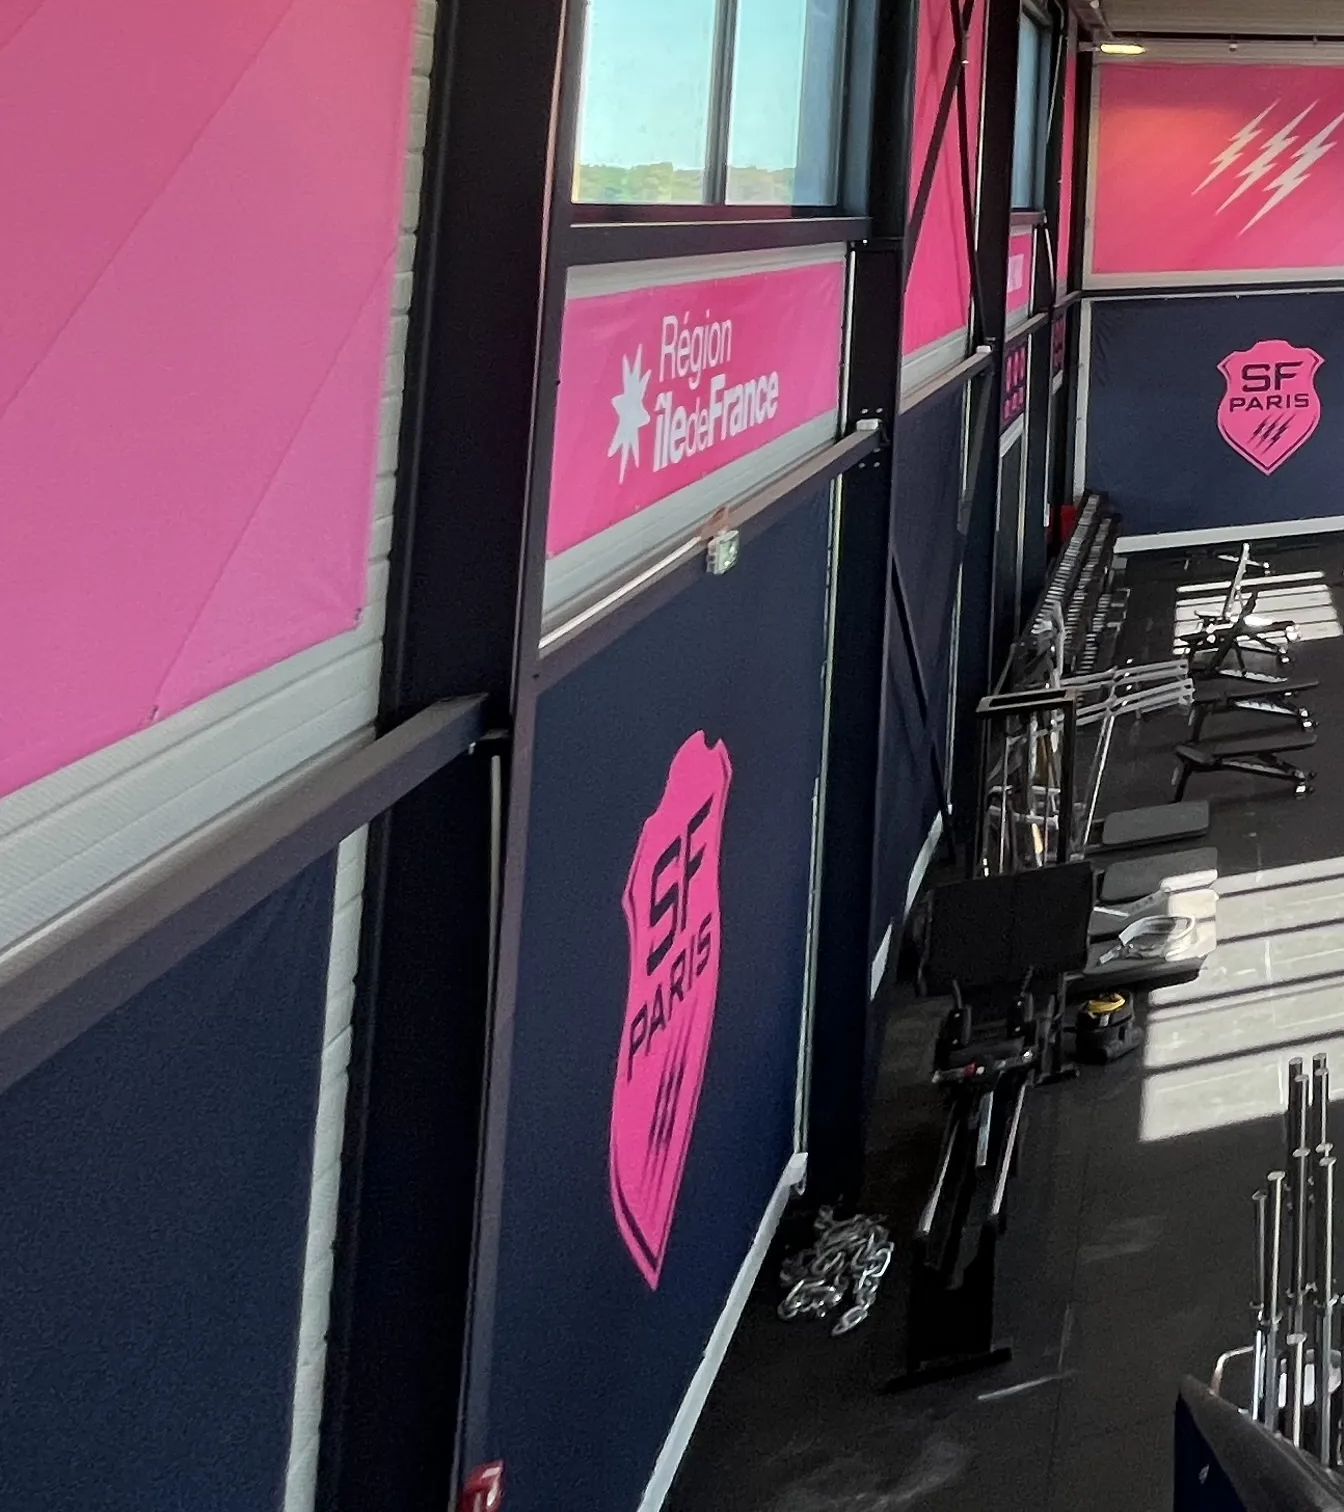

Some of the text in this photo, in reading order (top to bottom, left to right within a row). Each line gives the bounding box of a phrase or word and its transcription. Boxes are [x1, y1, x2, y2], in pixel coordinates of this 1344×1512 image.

[659, 308, 733, 390] Région
[1241, 360, 1304, 392] SF
[1229, 393, 1309, 412] PARIS
[646, 792, 714, 976] SF
[626, 913, 713, 1083] PARIS
